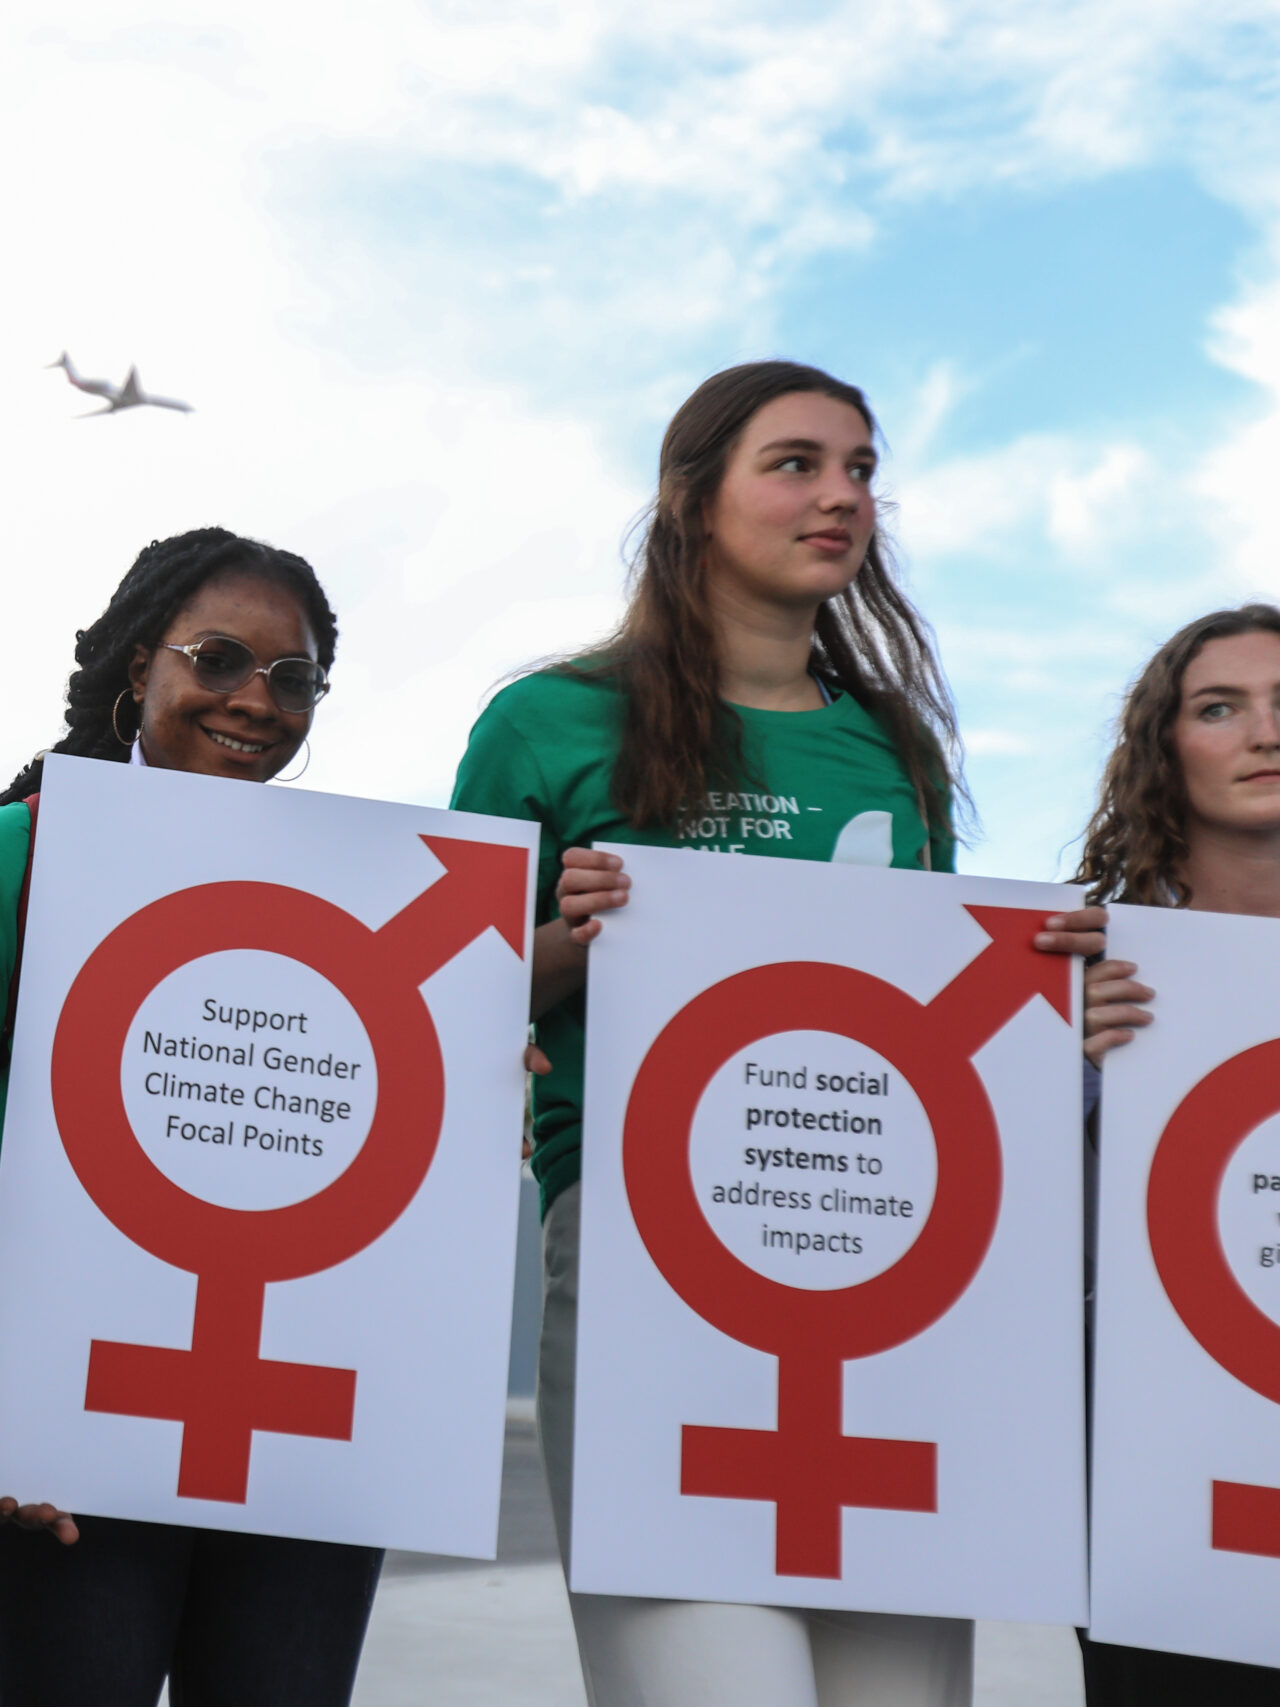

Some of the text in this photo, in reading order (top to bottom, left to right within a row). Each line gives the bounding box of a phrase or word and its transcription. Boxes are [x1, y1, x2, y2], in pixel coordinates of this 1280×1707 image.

[678, 791, 800, 815] EATION
[678, 816, 793, 840] NOT FOR
[202, 998, 308, 1034] Support
[143, 1030, 362, 1081] National Gender
[745, 1062, 889, 1097] Fund social
[144, 1071, 352, 1124] Climate Change
[166, 1114, 325, 1158] Focal Points
[746, 1106, 883, 1136] protection
[744, 1146, 883, 1176] systems to
[711, 1180, 915, 1219] address climate
[762, 1223, 864, 1255] impacts
